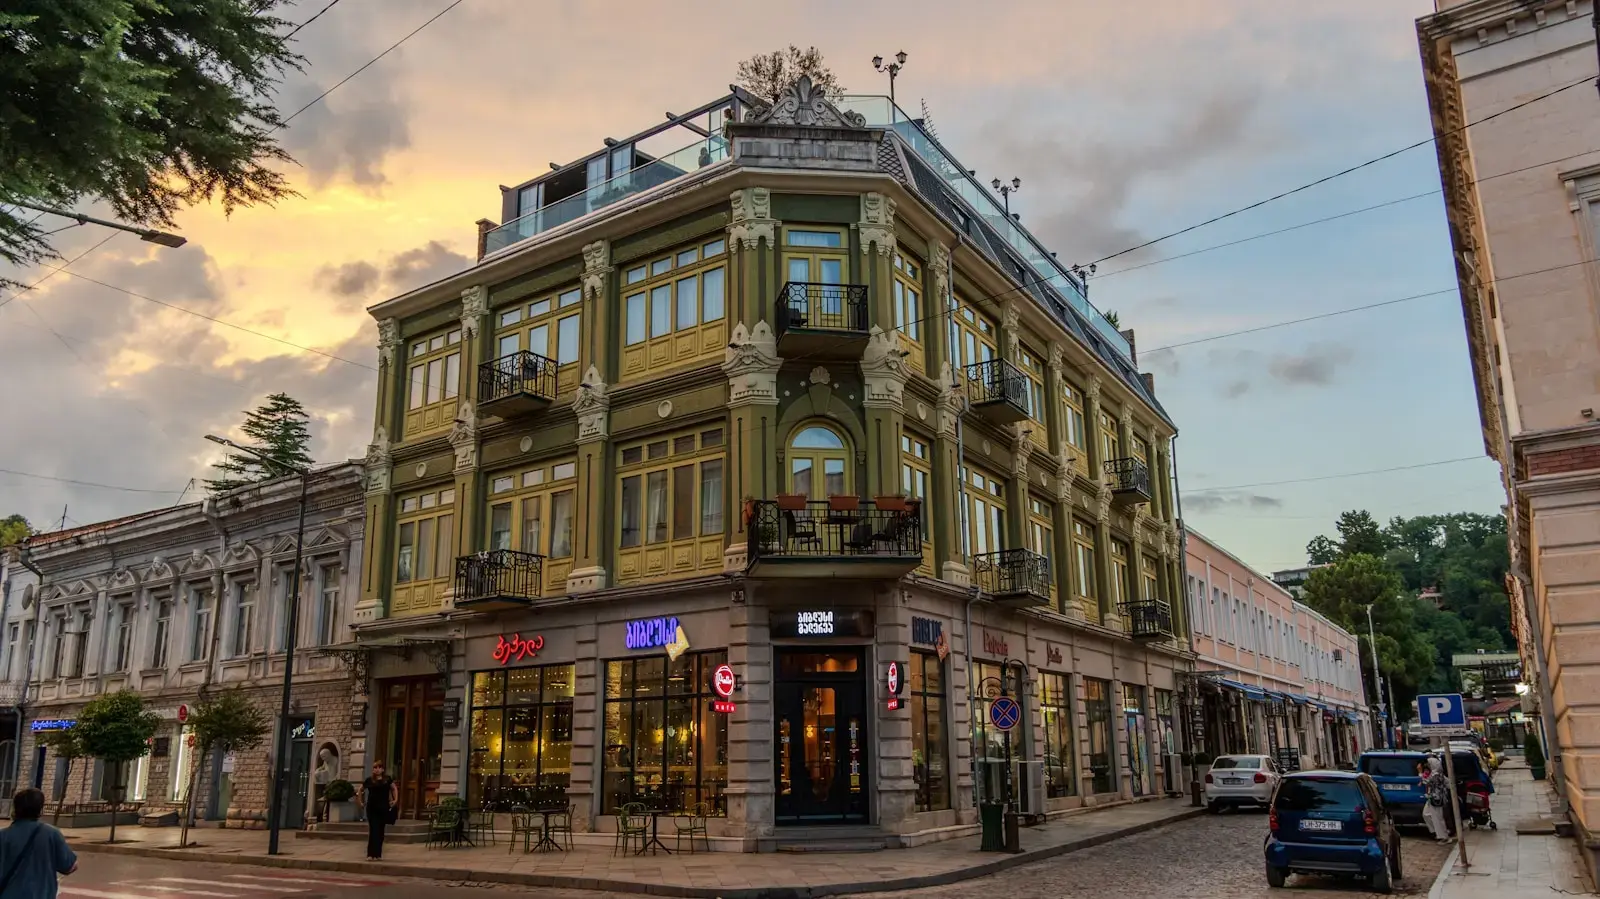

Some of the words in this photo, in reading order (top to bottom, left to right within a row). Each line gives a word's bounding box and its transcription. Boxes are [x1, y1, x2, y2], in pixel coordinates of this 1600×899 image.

[798, 611, 833, 623] ბიბლუსი
[626, 617, 678, 648] ბიბლუსი
[1428, 697, 1452, 723] P
